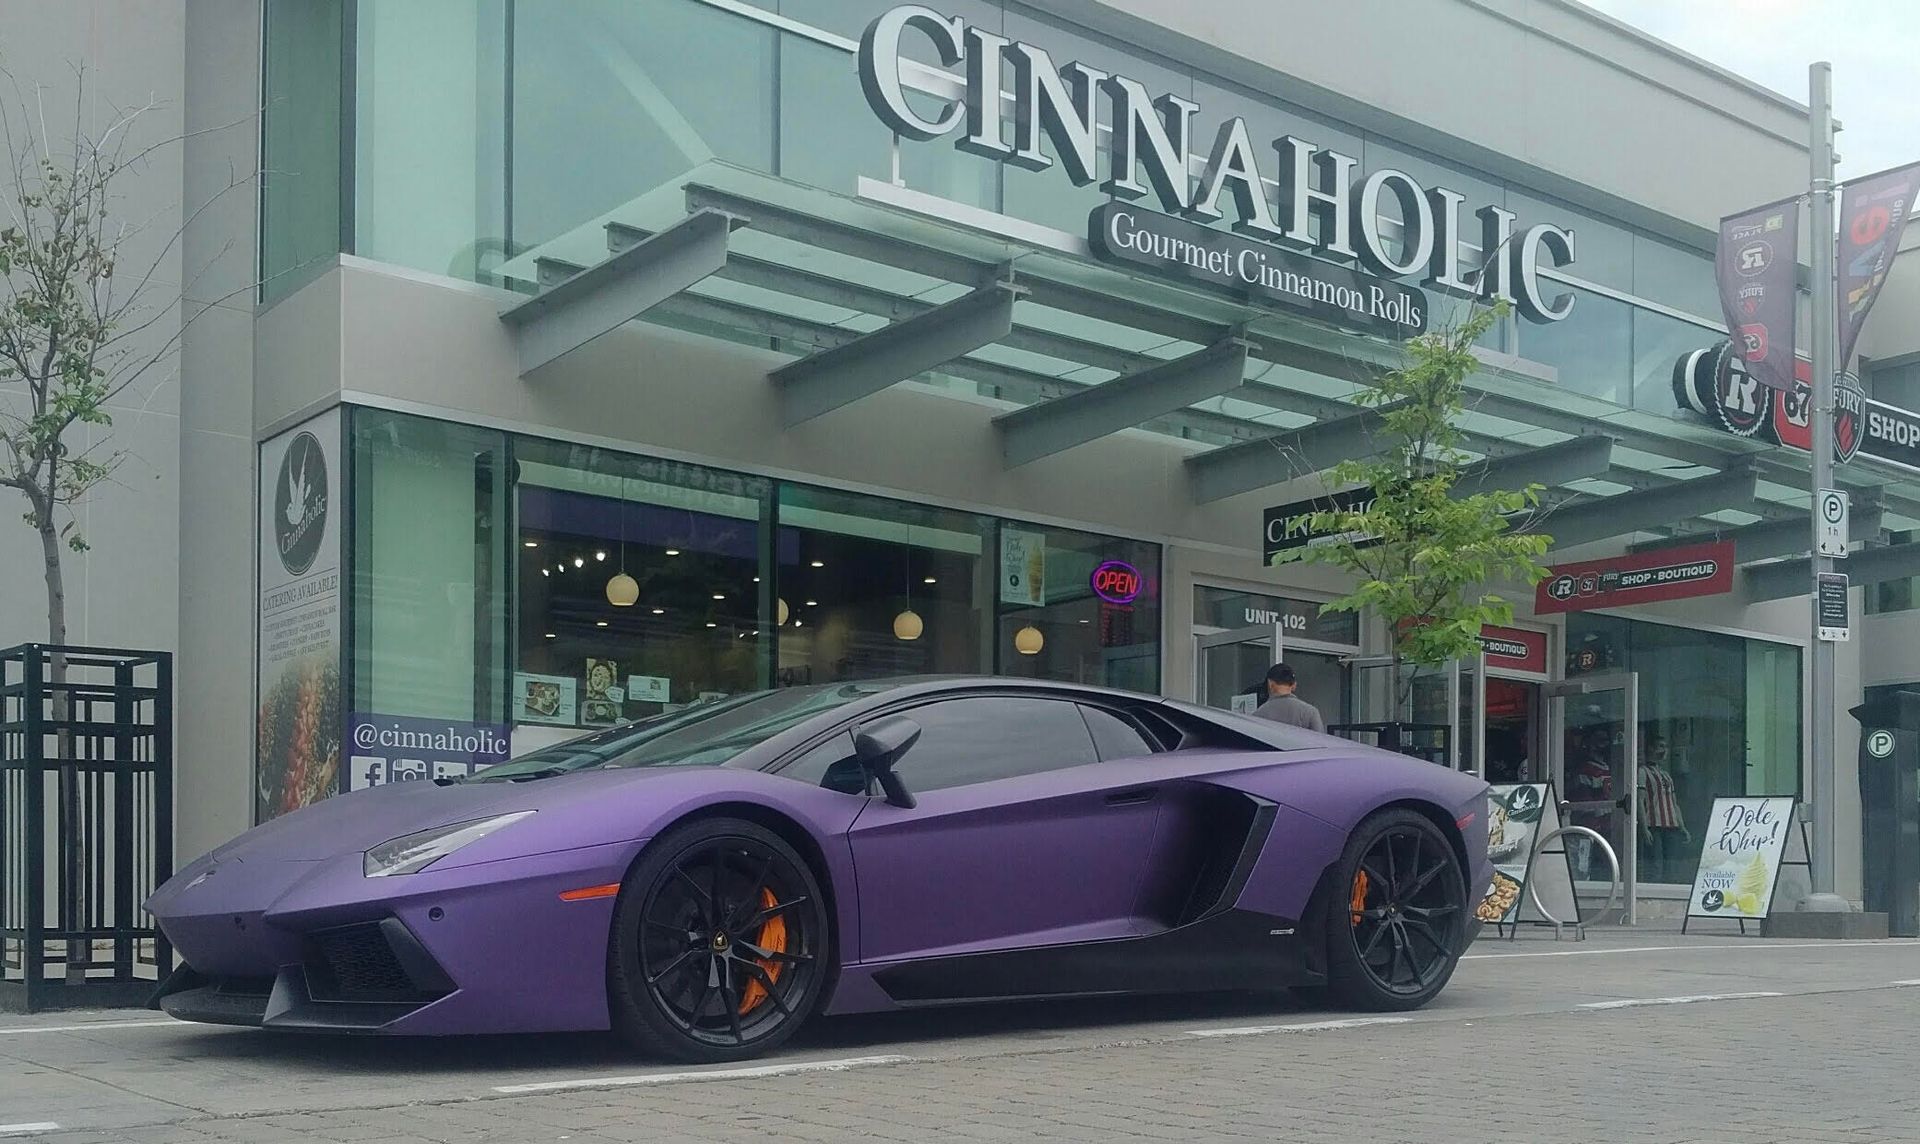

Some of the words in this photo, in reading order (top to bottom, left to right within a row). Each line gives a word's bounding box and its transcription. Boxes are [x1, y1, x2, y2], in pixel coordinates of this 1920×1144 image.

[863, 4, 1577, 323] CINNAHOLIC
[1110, 212, 1233, 276] Gourmet
[1238, 249, 1363, 312] Cinnamon
[1369, 285, 1421, 328] Rolls
[1833, 387, 1861, 416] FURY
[1868, 410, 1920, 448] SHOP
[1828, 501, 1838, 517] P
[1095, 570, 1138, 594] OPEN
[1621, 573, 1651, 586] SHOP
[1658, 562, 1714, 581] BOUTIQUE
[1245, 607, 1279, 625] UNIT
[1283, 613, 1306, 630] 102
[1489, 642, 1527, 655] BOUTIQUE
[354, 723, 508, 755] @cinnaholic
[1722, 798, 1776, 834] Dole
[1709, 820, 1780, 855] Whip!
[1701, 878, 1735, 889] NOW
[1703, 870, 1737, 879] Available
